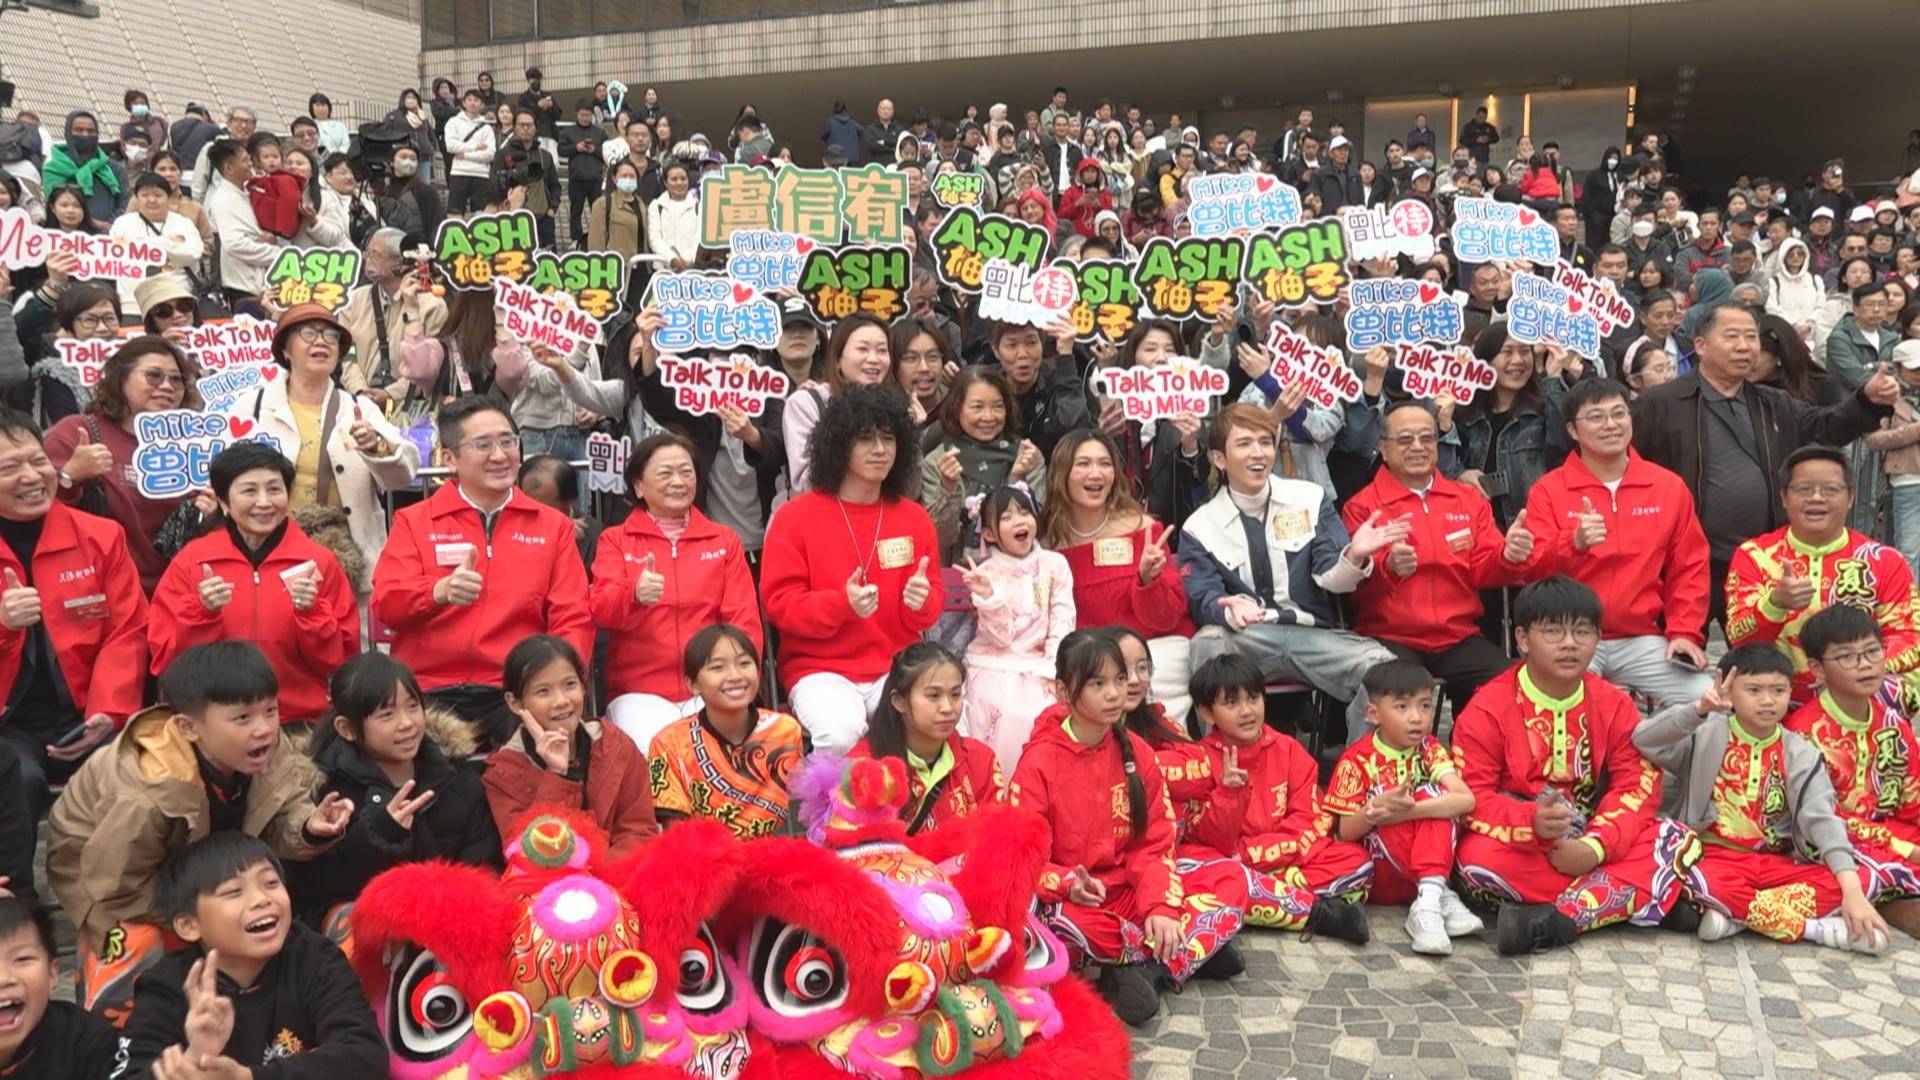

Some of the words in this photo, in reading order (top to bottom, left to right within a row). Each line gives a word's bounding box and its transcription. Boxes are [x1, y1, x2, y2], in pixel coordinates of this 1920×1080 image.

[935, 175, 982, 192] ASH
[1192, 176, 1255, 199] Mike
[705, 169, 902, 242] 盧信宥
[1191, 188, 1297, 236] 曾比特
[1457, 200, 1517, 222] Mike
[48, 233, 95, 255] Talk
[98, 238, 125, 258] To
[129, 242, 163, 262] Me
[439, 216, 532, 260] ASH
[733, 231, 795, 252] Mike
[938, 212, 1043, 268] ASH
[1249, 222, 1344, 279] ASH
[1456, 222, 1558, 261] 曾比特
[95, 260, 142, 278] Mike
[271, 251, 356, 283] ASH
[453, 251, 530, 284] 柚子
[531, 257, 618, 289] ASH
[730, 254, 805, 291] 曾比
[803, 252, 904, 291] ASH
[945, 244, 984, 287] 柚
[1139, 243, 1240, 282] ASH
[278, 278, 345, 310] 柚子
[658, 278, 731, 300] Mike
[1152, 275, 1234, 315] 柚子
[1263, 261, 1345, 302] 柚子
[1352, 281, 1418, 306] Mike
[1515, 274, 1568, 306] Mike
[1555, 261, 1589, 297] Talk
[1588, 285, 1607, 307] To
[1608, 301, 1632, 325] Me
[498, 280, 538, 316] Talk
[541, 299, 563, 325] To
[565, 310, 598, 340] Me
[816, 285, 901, 321] 柚子
[227, 326, 251, 346] To
[506, 311, 529, 338] By
[531, 323, 574, 353] Mike
[656, 301, 778, 347] 曾比特
[1350, 301, 1461, 349] 曾比特
[1511, 298, 1599, 356] 曾比特
[60, 342, 110, 362] Talk
[202, 350, 226, 368] By
[229, 345, 271, 364] Mike
[1272, 325, 1309, 361] Talk
[1311, 349, 1332, 375] To
[1332, 366, 1359, 398] Me
[1397, 344, 1439, 371] Talk
[1441, 353, 1463, 377] To
[1464, 362, 1494, 387] Me
[200, 368, 261, 400] Mike
[661, 359, 712, 388] Talk
[715, 366, 744, 389] To
[748, 370, 785, 393] Me
[1105, 371, 1155, 394] Talk
[1157, 370, 1185, 391] To
[1189, 369, 1225, 392] Me
[1406, 370, 1427, 396] By
[679, 388, 705, 410] By
[710, 390, 761, 414] Mike
[1127, 397, 1151, 418] By
[1157, 396, 1206, 416] Mike
[140, 412, 227, 442] Mike
[139, 433, 280, 494] 曾比
